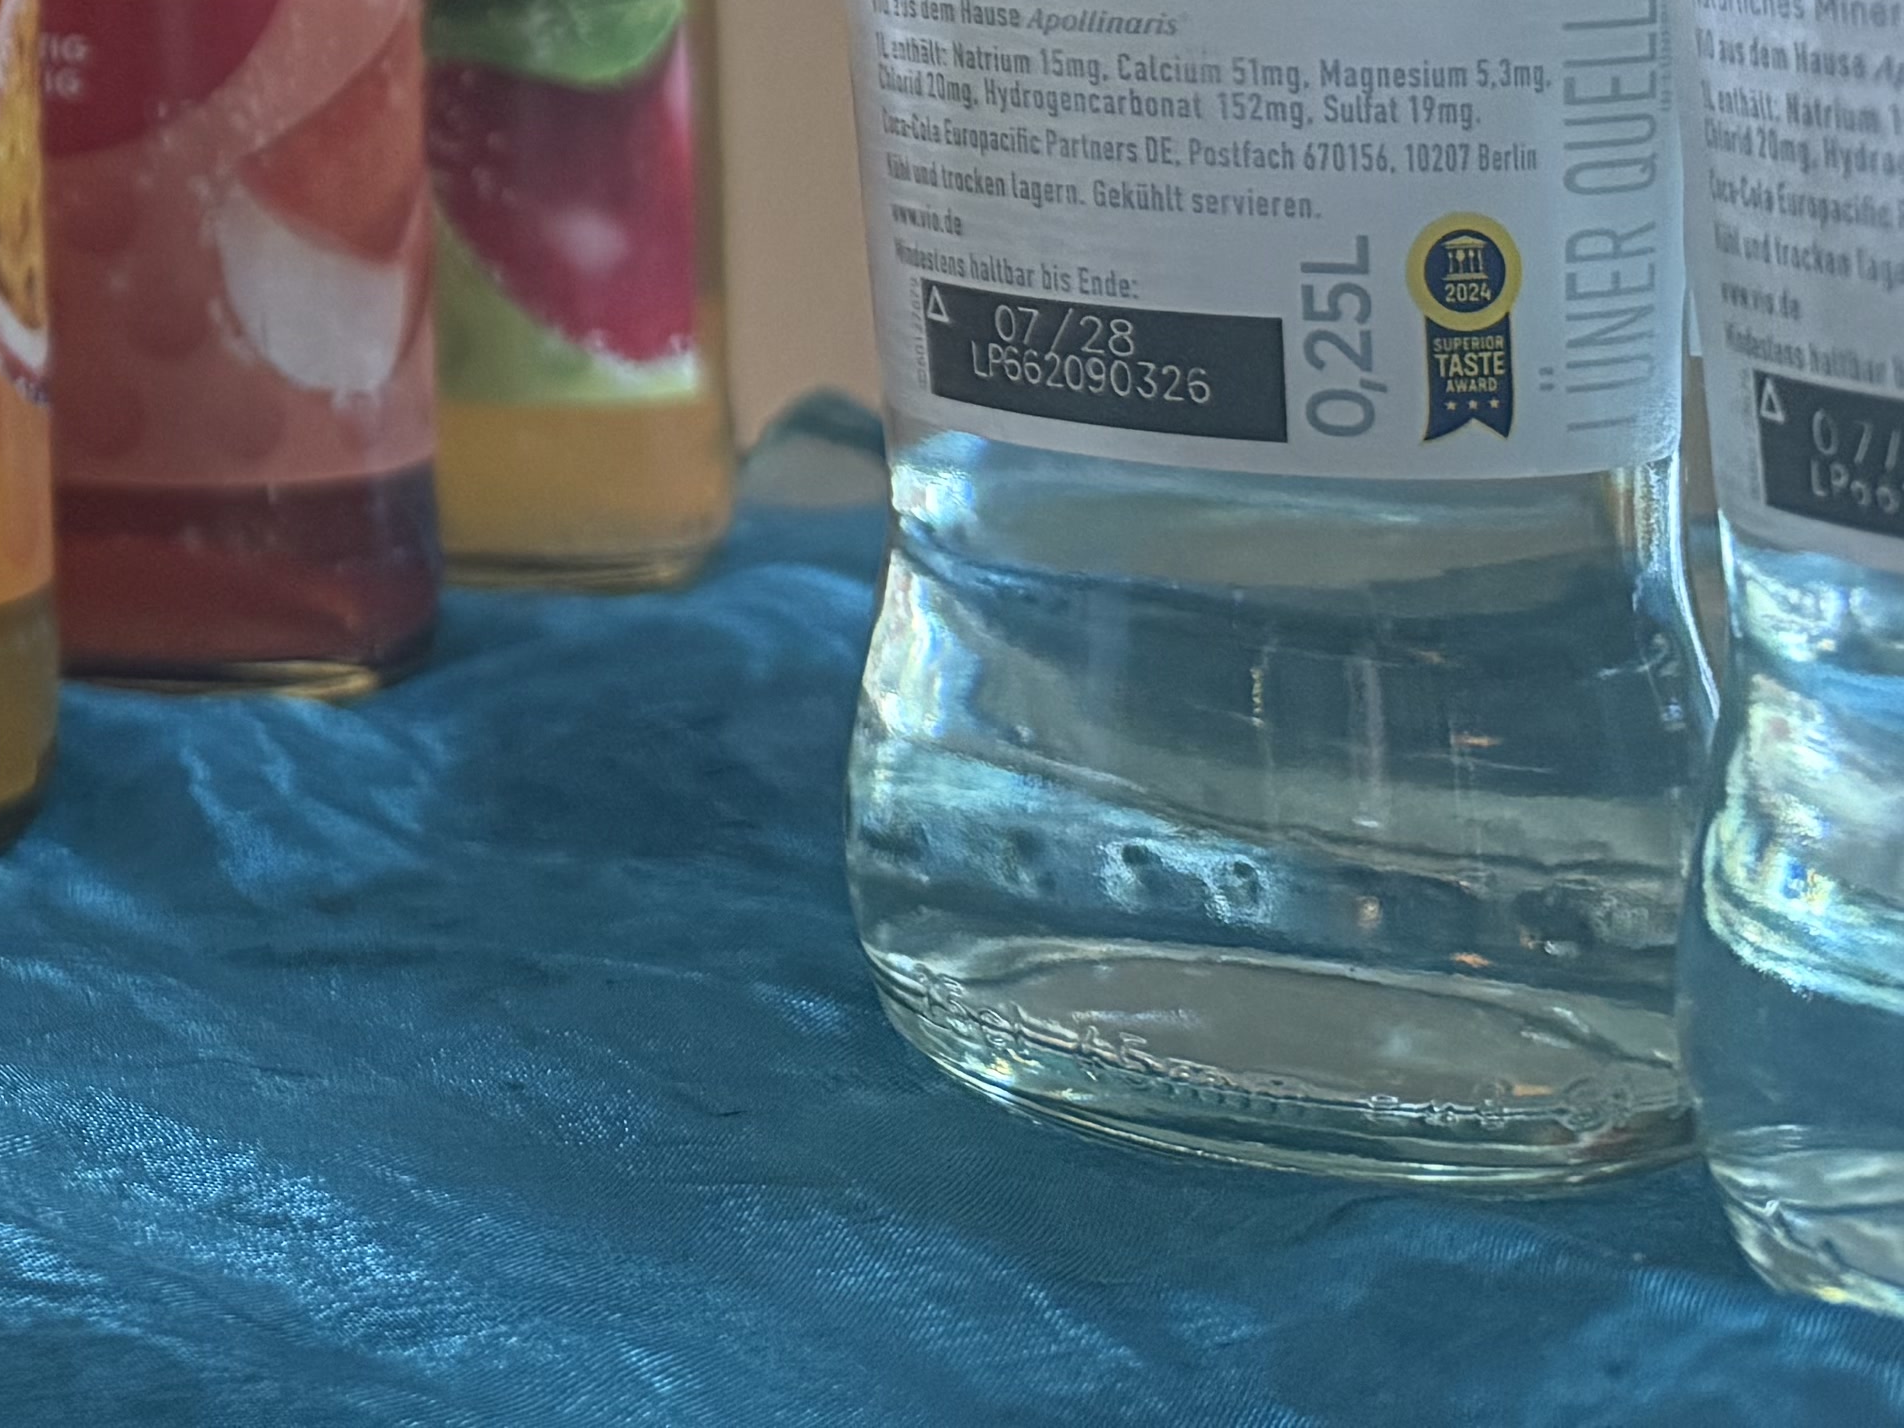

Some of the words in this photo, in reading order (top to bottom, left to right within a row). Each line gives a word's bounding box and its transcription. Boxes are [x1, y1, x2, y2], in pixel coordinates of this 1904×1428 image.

[1027, 7, 1178, 37] Apollinaris
[953, 41, 1031, 74] Natrium
[1117, 53, 1222, 85] Calcium
[1320, 58, 1468, 95] Magnesium
[985, 79, 1203, 121] Hydrogencarbonat
[1324, 94, 1398, 125] Sulfat
[944, 118, 1042, 157] Europacific
[1046, 129, 1138, 164] Partners
[1189, 139, 1294, 172] Postfach
[1407, 143, 1471, 173] 10207
[1478, 143, 1538, 172] Berlin
[913, 160, 938, 188] und
[942, 165, 1006, 198] trocken
[1093, 179, 1184, 213] Gekühlt
[1192, 187, 1323, 220] servieren.
[891, 203, 964, 236] www.vio.de
[970, 253, 1035, 289] haltbar
[1042, 262, 1072, 294] bis
[1079, 265, 1141, 300] Ende:
[1444, 282, 1492, 304] 2024
[1300, 234, 1388, 437] 0,25L
[1433, 334, 1505, 354] SUPERIOR
[1434, 350, 1507, 379] TASTE
[1445, 376, 1499, 394] AWARD
